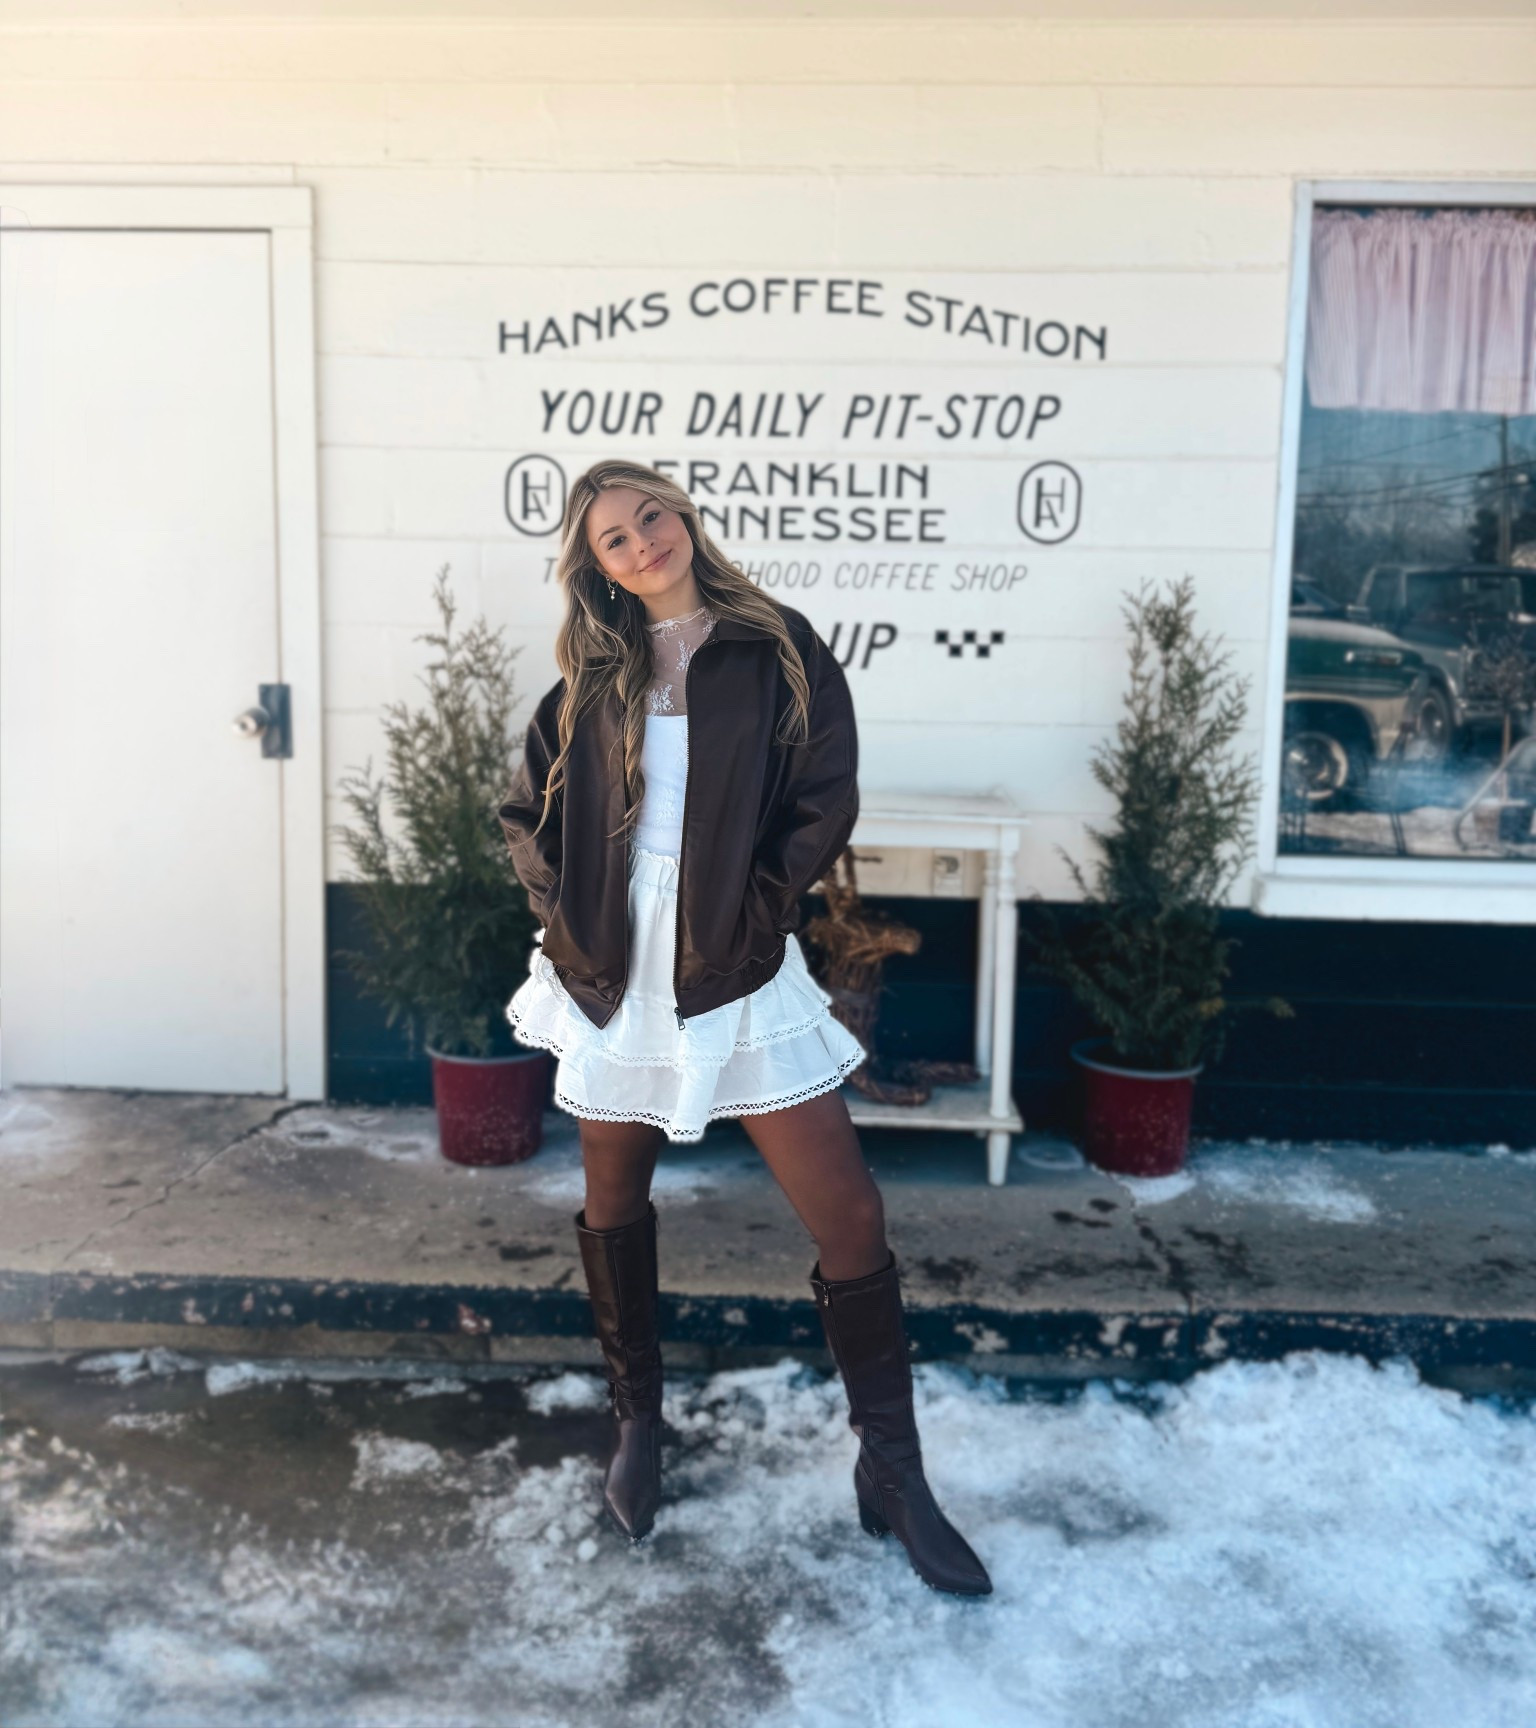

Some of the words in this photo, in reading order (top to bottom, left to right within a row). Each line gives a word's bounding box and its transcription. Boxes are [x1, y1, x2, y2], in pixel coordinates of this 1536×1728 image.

[498, 292, 671, 354] HANKS
[689, 278, 884, 318] COFFEE
[904, 290, 1107, 361] STATION
[540, 389, 664, 436] YOUR
[686, 391, 825, 438] DAILY
[843, 393, 1062, 440] PIT-STOP
[698, 505, 946, 543] NNESSEE
[834, 562, 940, 591] COFFEE
[950, 563, 1029, 592] SHOP
[828, 621, 899, 670] UP
